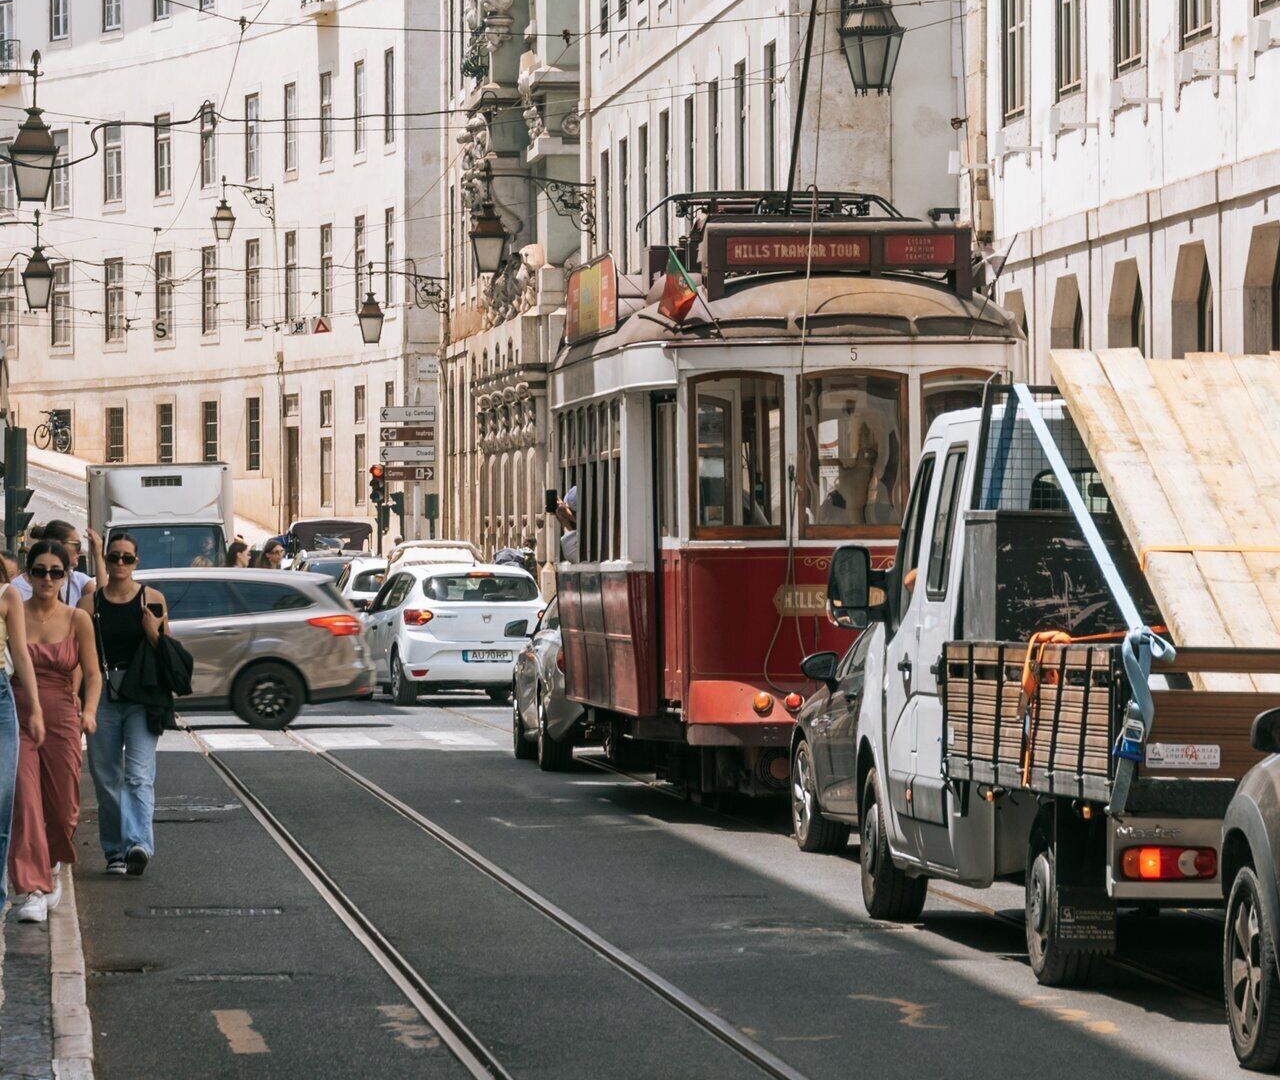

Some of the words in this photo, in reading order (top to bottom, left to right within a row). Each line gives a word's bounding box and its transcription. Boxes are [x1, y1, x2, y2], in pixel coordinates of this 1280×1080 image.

[734, 244, 770, 259] HILLS
[773, 243, 827, 258] TRAMCAR
[829, 243, 860, 257] TOUR
[155, 322, 167, 338] S
[850, 347, 858, 362] 5
